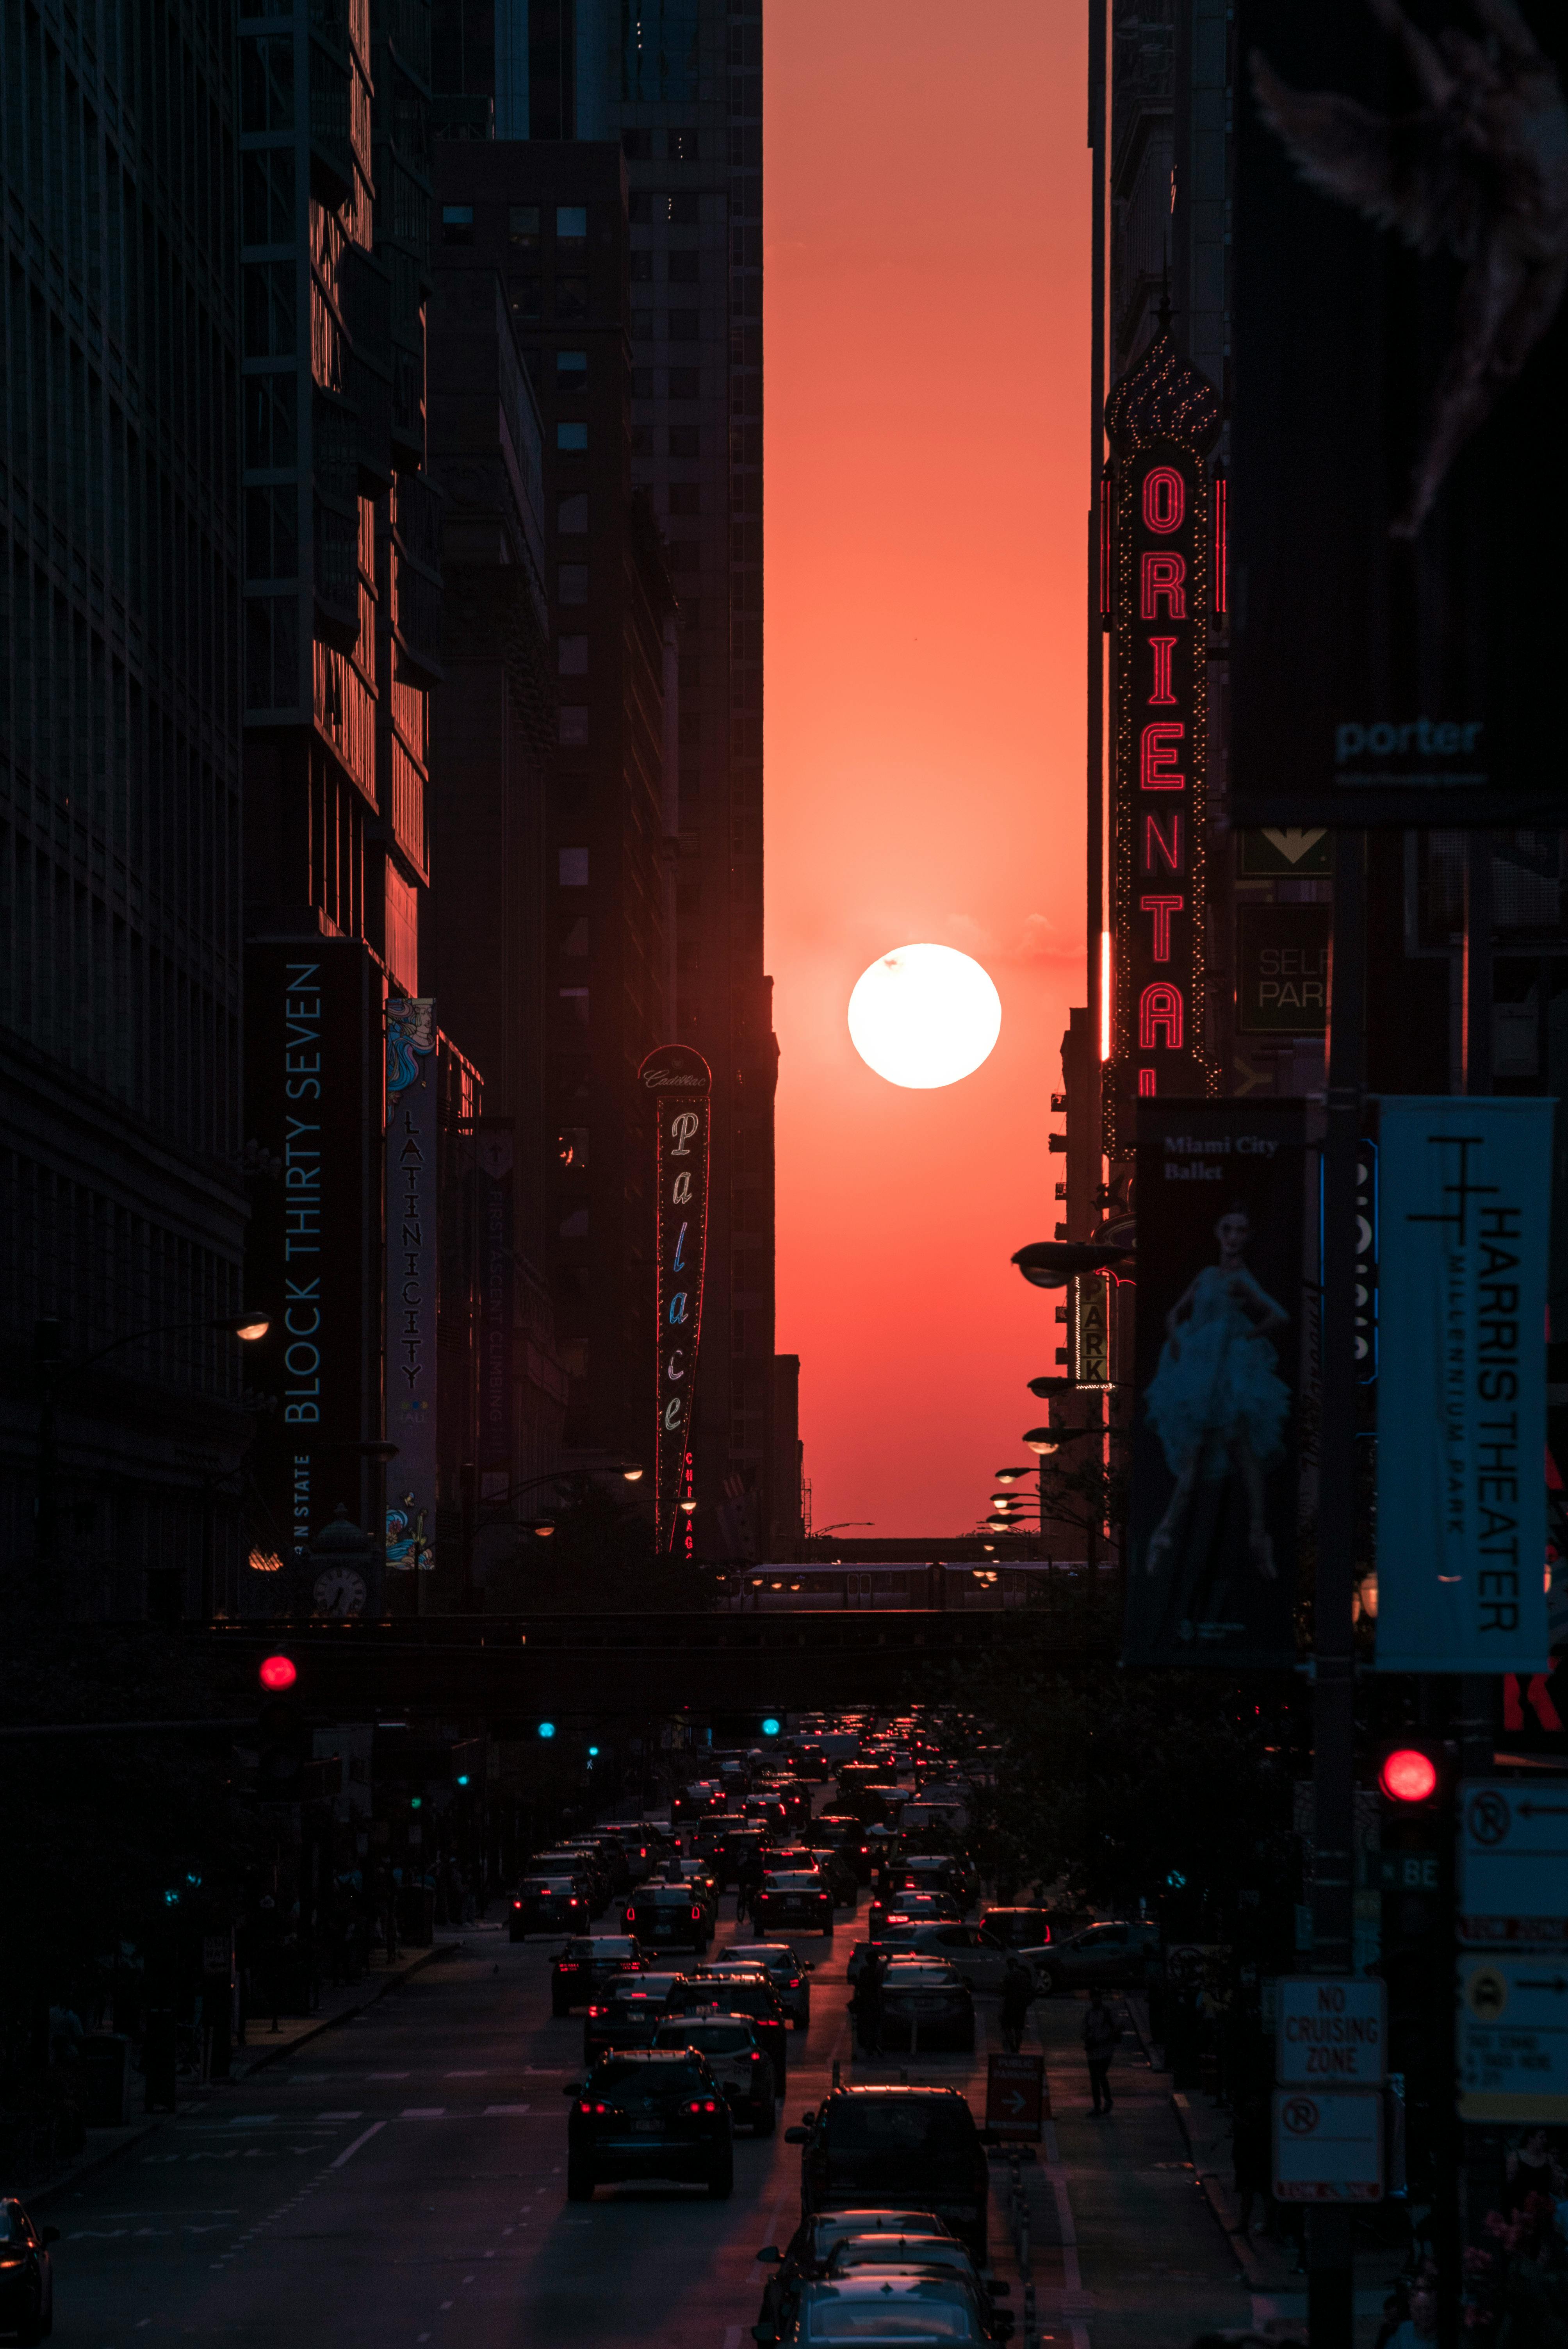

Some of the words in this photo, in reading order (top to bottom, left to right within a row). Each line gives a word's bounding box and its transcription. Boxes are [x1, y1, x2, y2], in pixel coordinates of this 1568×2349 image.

[1335, 716, 1483, 764] porter
[1259, 981, 1324, 1007] PAR
[286, 964, 321, 1100] SEVEN
[643, 1070, 706, 1088] Cadillac
[1164, 1137, 1231, 1154] Miami
[1235, 1137, 1279, 1158] City
[1164, 1162, 1224, 1180] Ballet
[286, 1115, 321, 1261] THIRTY
[490, 1191, 504, 1242] FIRST
[400, 1111, 424, 1389] LATINICITY
[665, 1112, 698, 1430] Palace
[490, 1249, 504, 1324] ASCENT
[285, 1276, 321, 1423] BLOCK
[1084, 1277, 1103, 1380] PARK
[1446, 1255, 1466, 1443] MILLENNIUM
[489, 1330, 504, 1422] CLIMBING
[294, 1455, 310, 1517] STATE
[1447, 1458, 1465, 1533] PARK
[294, 1526, 310, 1537] N
[1317, 1986, 1345, 2013] NO
[1286, 2016, 1378, 2043] CRUISING
[998, 2058, 1034, 2069] PUBLIC
[1306, 2046, 1358, 2073] ZONE
[66, 2223, 233, 2240] NLY
